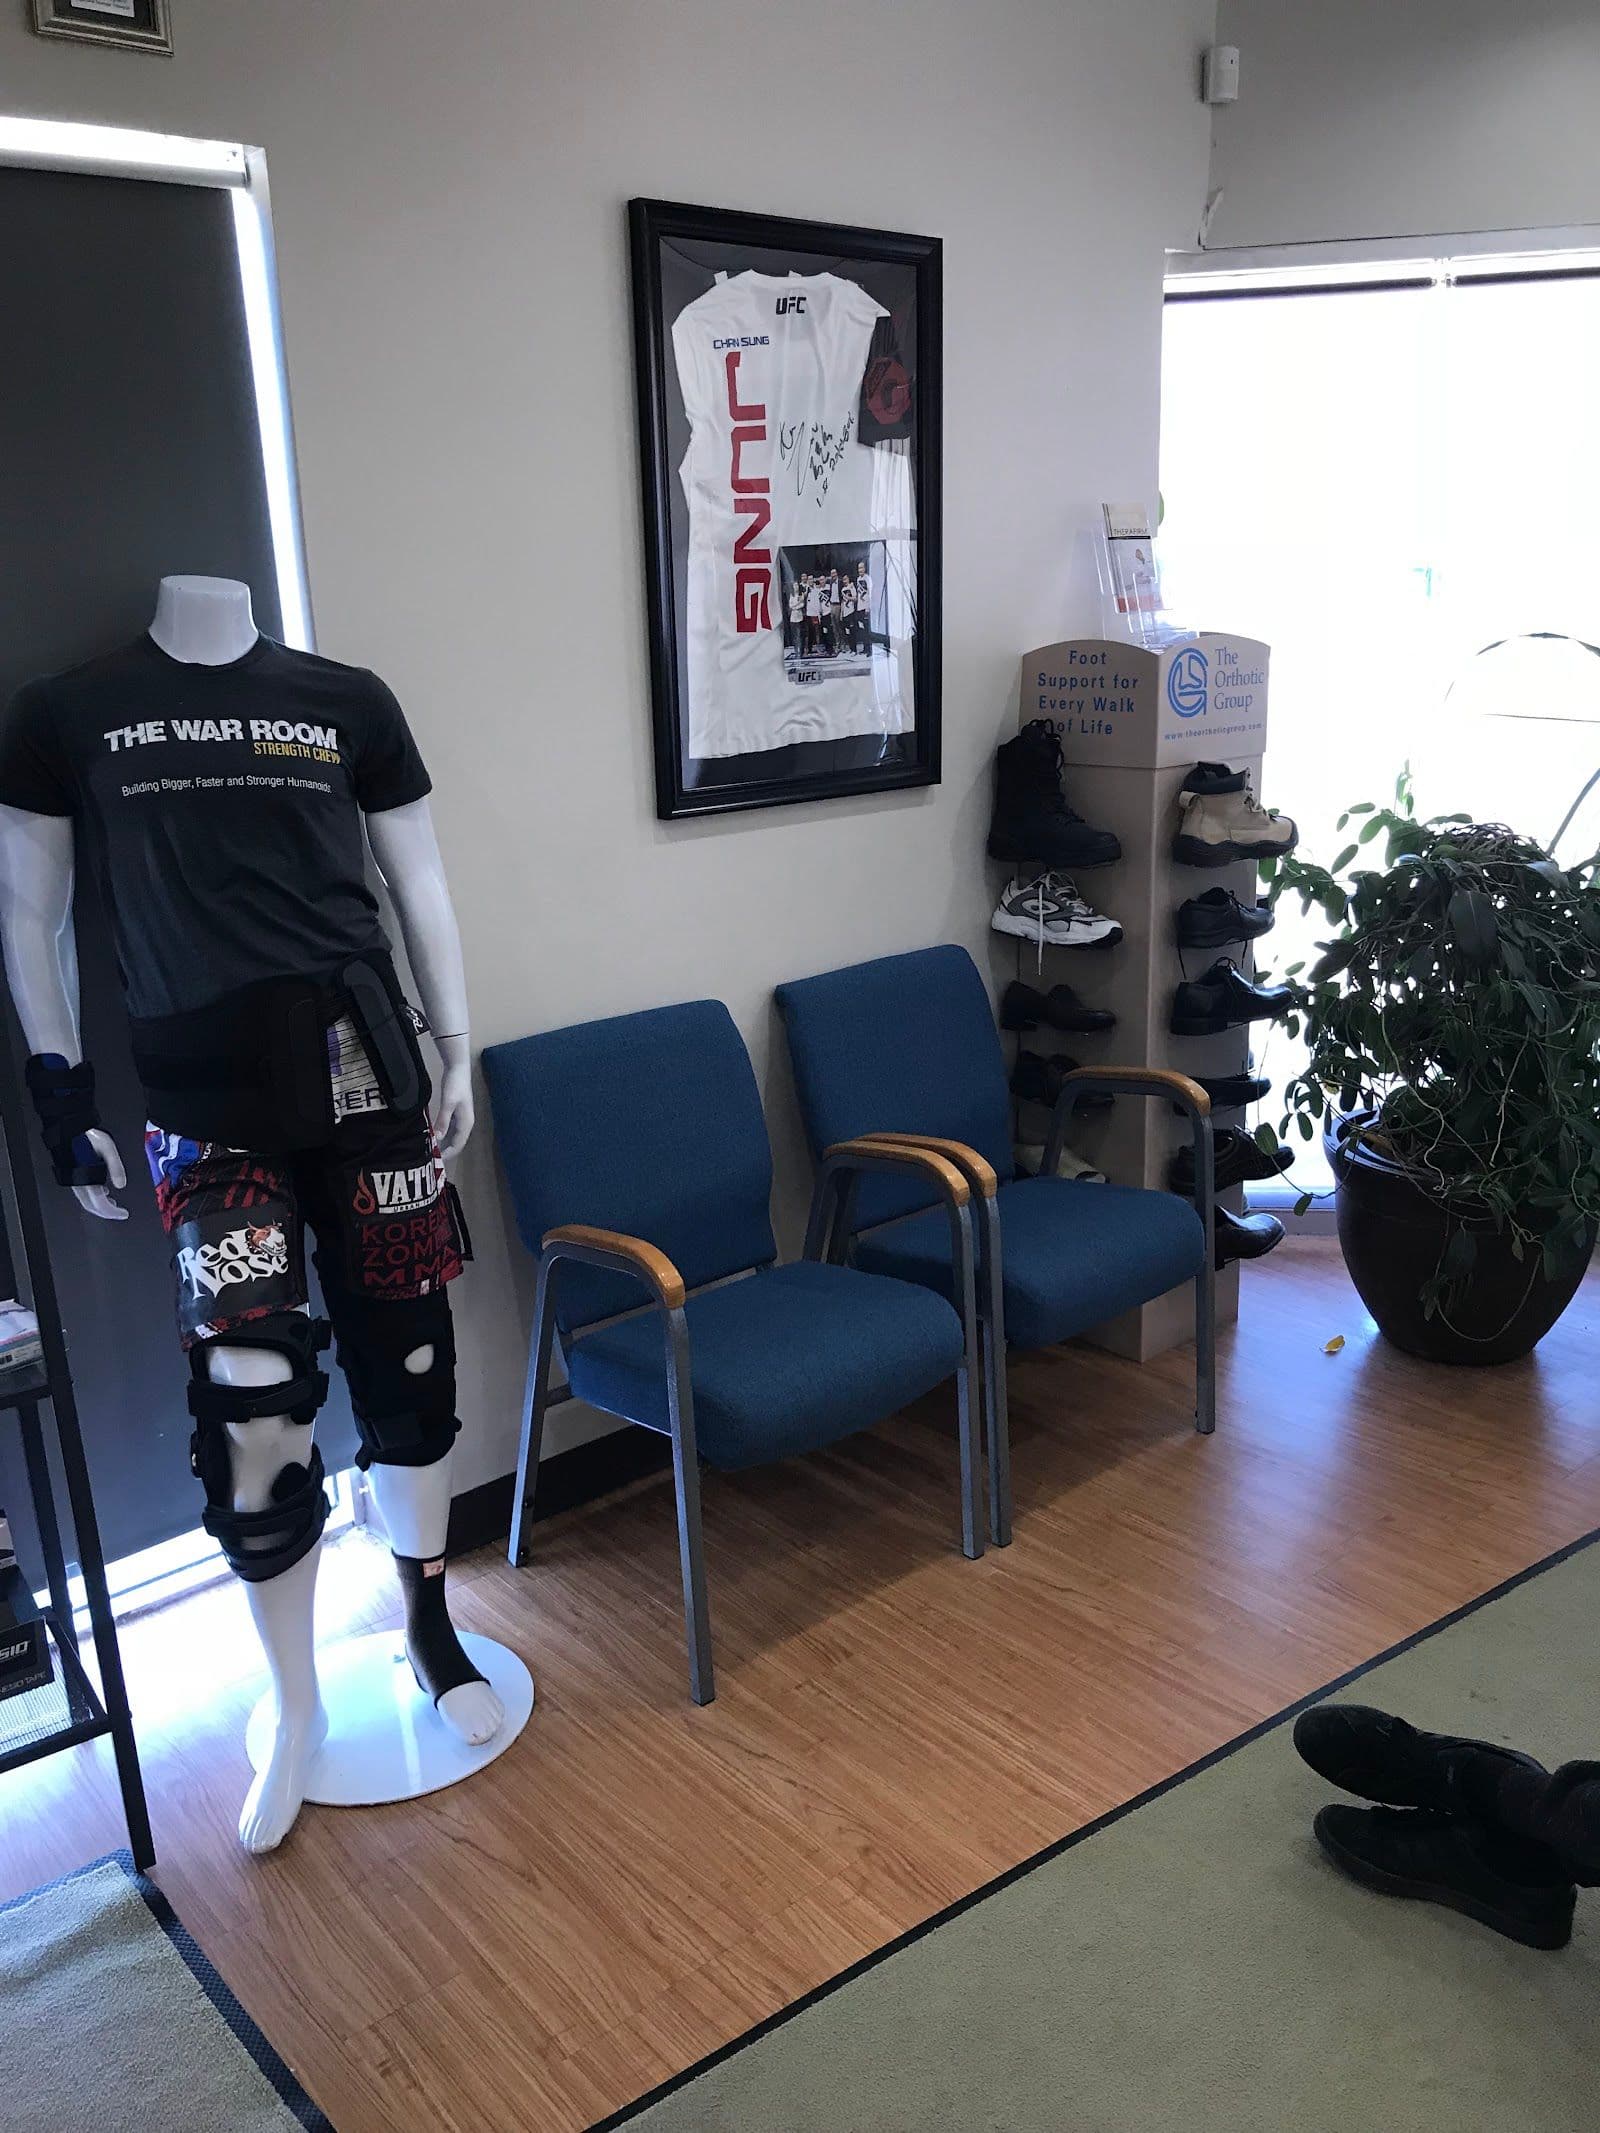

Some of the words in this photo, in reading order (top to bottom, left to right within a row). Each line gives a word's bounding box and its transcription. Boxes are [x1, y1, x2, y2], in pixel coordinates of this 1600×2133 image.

[775, 296, 807, 315] UFC
[713, 338, 740, 350] CHAN
[741, 336, 770, 347] SUNG
[725, 351, 773, 633] JUNG
[1069, 650, 1107, 665] Foot
[1215, 647, 1239, 666] The
[798, 671, 817, 682] UFC
[1037, 672, 1105, 691] Support
[1112, 674, 1139, 689] for
[1214, 668, 1265, 688] Orthotic
[1039, 695, 1084, 714] Every
[1093, 696, 1135, 713] Walk
[1214, 693, 1253, 713] Group
[103, 720, 168, 752] THE
[170, 719, 244, 742] WAR
[249, 719, 338, 750] ROOM
[1081, 719, 1114, 735] Life
[254, 742, 311, 759] STRENGTH
[312, 747, 341, 765] CREW
[121, 781, 160, 797] Building
[161, 776, 194, 791] Bigger,
[196, 777, 225, 788] Faster
[226, 775, 245, 787] and
[246, 775, 286, 789] Stronger
[287, 776, 333, 795] Humanoids.
